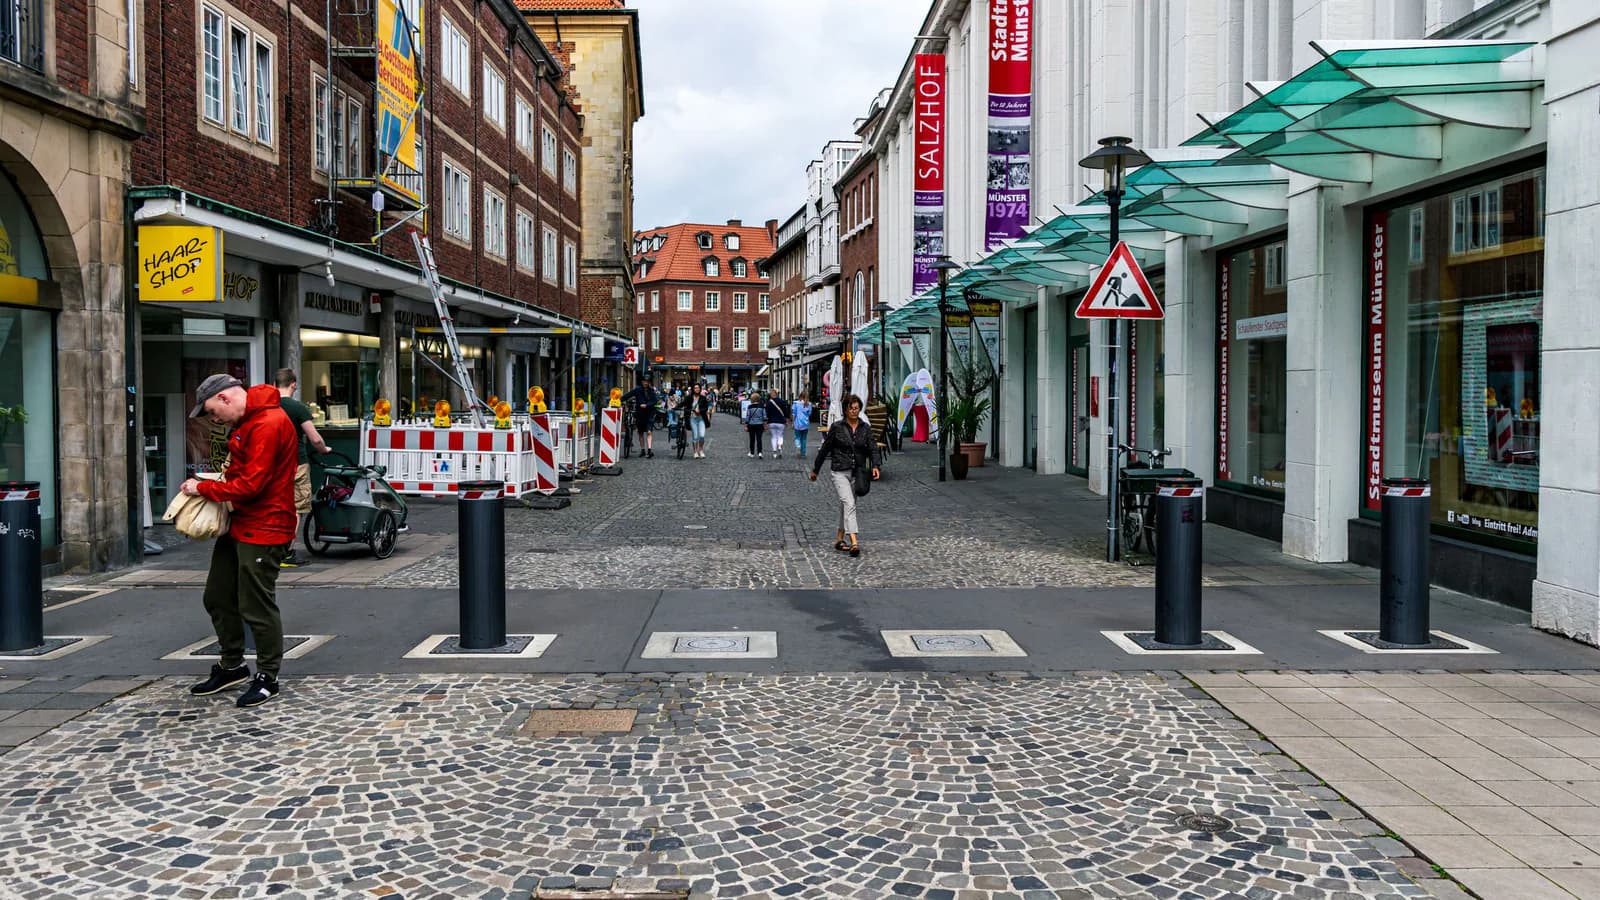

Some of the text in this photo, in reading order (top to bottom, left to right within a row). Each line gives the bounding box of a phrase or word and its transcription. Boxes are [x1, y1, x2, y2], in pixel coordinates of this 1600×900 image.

[919, 66, 940, 179] SALZHOF
[988, 193, 1027, 202] MÜNSTER
[988, 202, 1028, 218] 1974
[144, 238, 208, 272] HAAR-
[150, 258, 202, 289] SHOP
[223, 271, 258, 301] HOP
[1219, 265, 1228, 473] Stadtmuseum Münster
[1369, 224, 1384, 500] Stadtmuseum Münster
[1484, 519, 1507, 532] Eintritt
[1507, 522, 1521, 535] frei!
